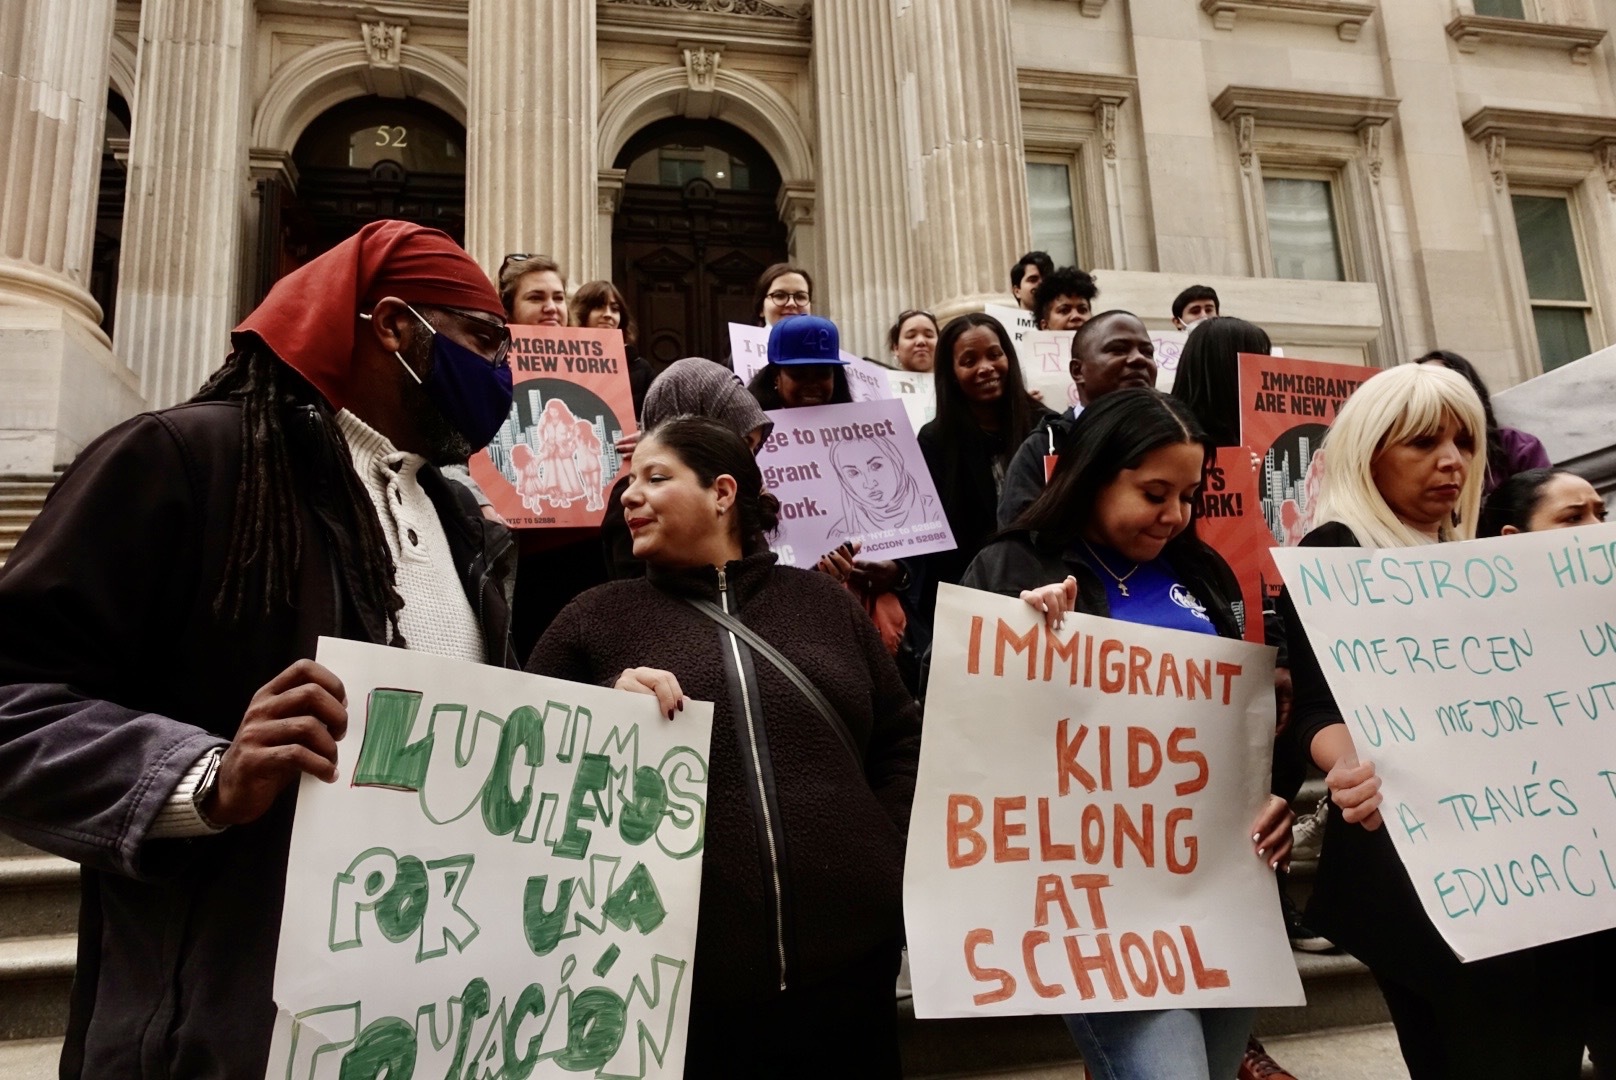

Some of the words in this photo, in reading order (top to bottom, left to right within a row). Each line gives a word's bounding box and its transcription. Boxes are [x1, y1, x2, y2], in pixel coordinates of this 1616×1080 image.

[375, 125, 407, 147] 52
[508, 338, 603, 356] MIGRANTS
[516, 355, 558, 372] NEW
[563, 357, 618, 374] YORK!
[846, 365, 880, 388] otect
[1255, 392, 1286, 413] ARE
[1291, 395, 1327, 417] NEW
[764, 431, 789, 453] ge
[793, 428, 815, 444] to
[819, 419, 895, 447] protect
[763, 461, 821, 488] grant
[1195, 493, 1243, 519] ORK!
[899, 527, 909, 535] to
[916, 532, 947, 543] 52886
[1299, 556, 1518, 606] NUESTROS
[967, 615, 1242, 705] IMMIGRANT
[1329, 629, 1533, 675] MERECEN
[1355, 705, 1416, 747] UN
[1435, 696, 1538, 738] MEJOR
[351, 687, 709, 860] LUCHEMOS
[1056, 718, 1209, 796] KIDS
[1397, 802, 1429, 844] A
[1438, 761, 1578, 826] TRAVÉS
[946, 793, 1198, 875] BELONG
[329, 847, 480, 964] POR
[523, 854, 667, 956] UNA
[1034, 873, 1114, 930] AT
[963, 925, 1231, 1007] SCHOOL
